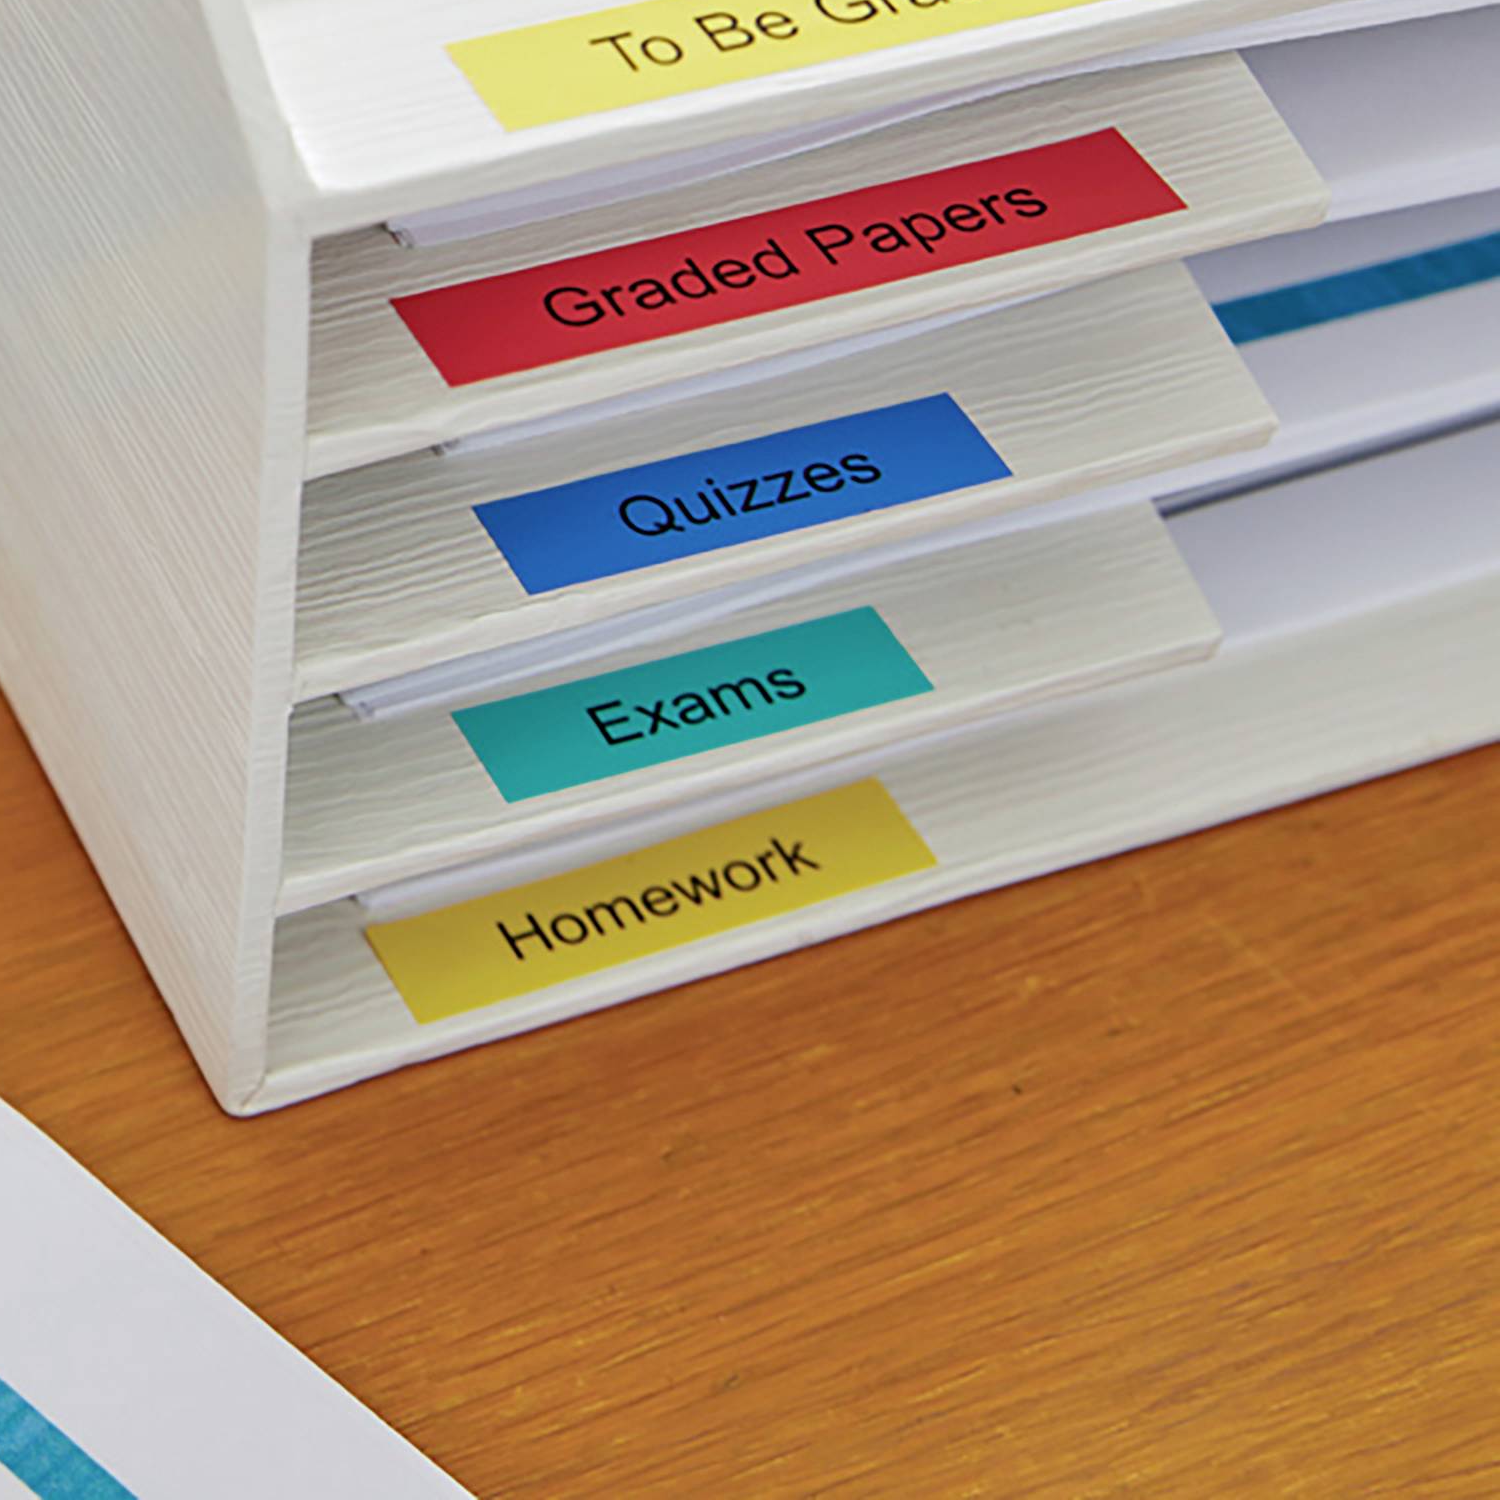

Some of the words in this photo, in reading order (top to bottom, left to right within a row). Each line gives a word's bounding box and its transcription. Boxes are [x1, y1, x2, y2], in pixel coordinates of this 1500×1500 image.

[589, 31, 684, 73] To
[694, 11, 798, 53] Be
[542, 239, 800, 328] Graded
[806, 185, 1048, 265] Papers
[618, 452, 881, 537] Quizzes
[585, 667, 806, 746] Exams
[496, 837, 820, 961] Homework
